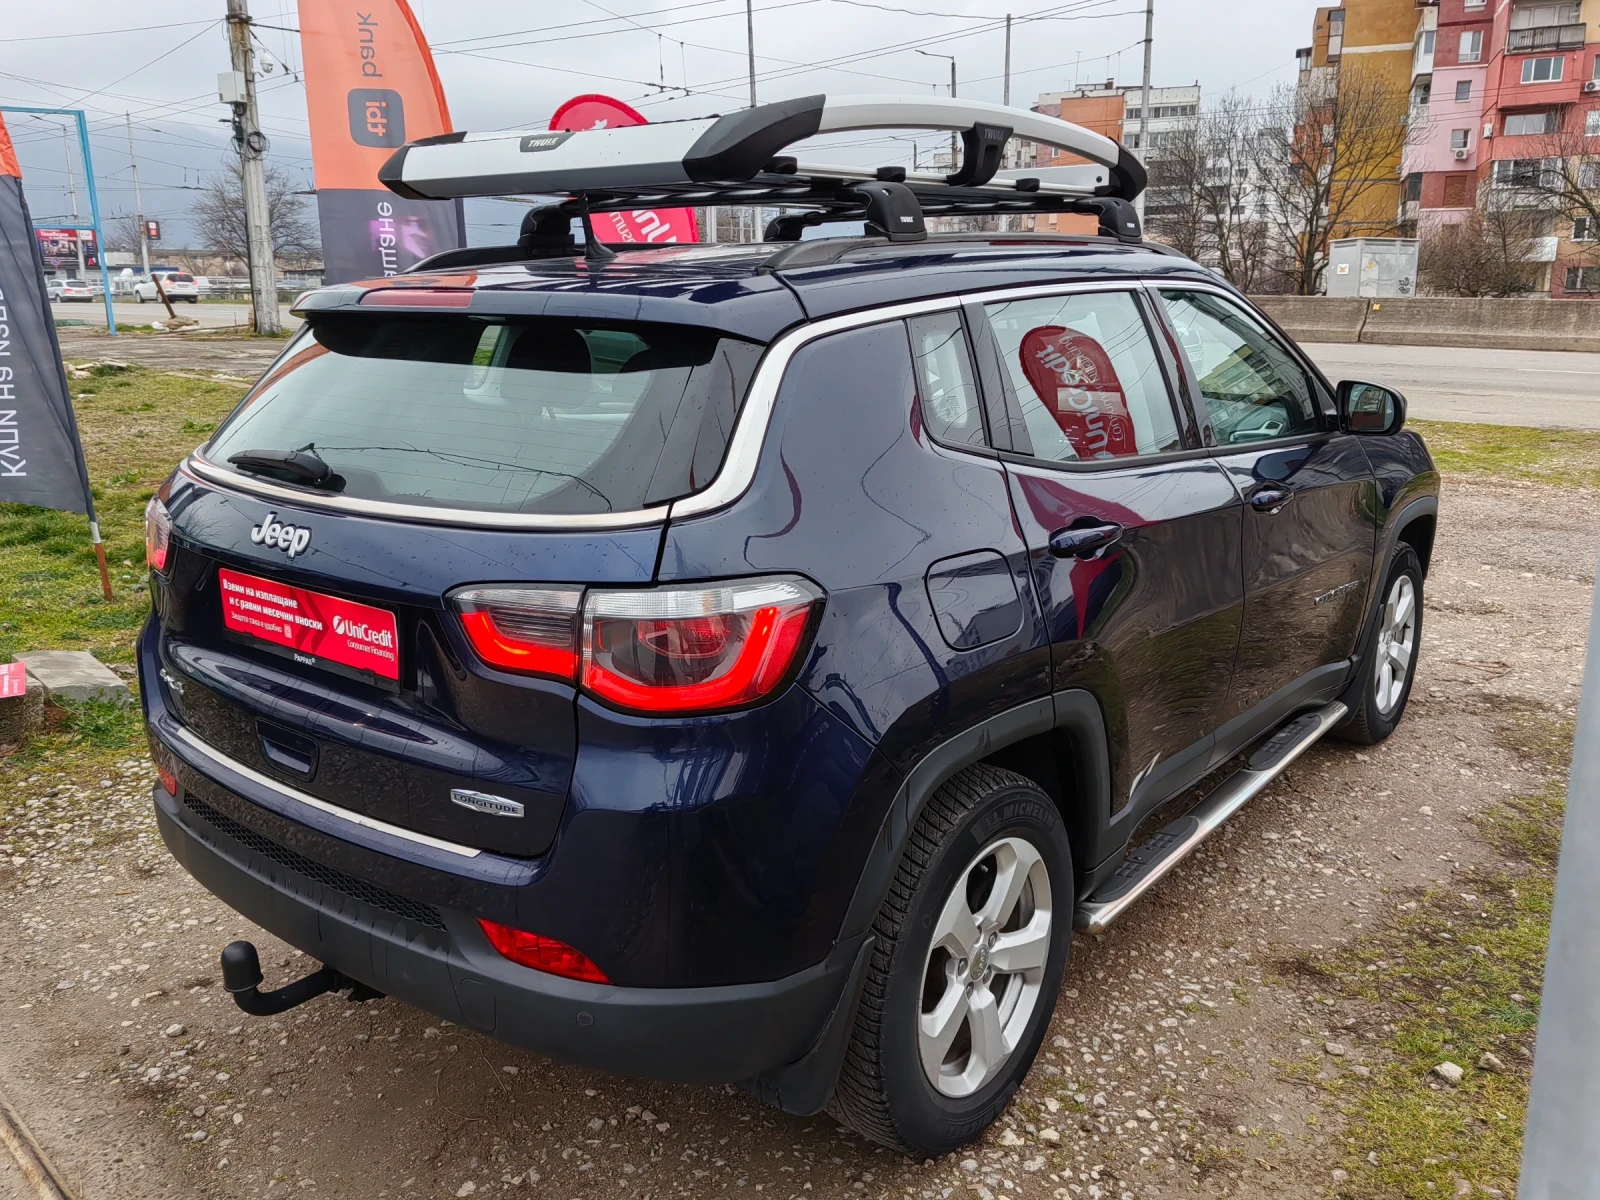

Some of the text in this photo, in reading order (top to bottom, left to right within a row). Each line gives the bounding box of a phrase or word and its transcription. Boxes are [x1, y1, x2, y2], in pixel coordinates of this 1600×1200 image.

[527, 137, 559, 148] THULE
[250, 510, 312, 560] Jeep
[222, 578, 298, 608] Вземи на изплащане
[229, 597, 323, 630] и с равни месечни вноски
[345, 619, 393, 648] UniCredit
[347, 639, 395, 662] Consumer Financing
[453, 792, 520, 814] LONGITUDE
[1003, 802, 1055, 828] MICHELIN
